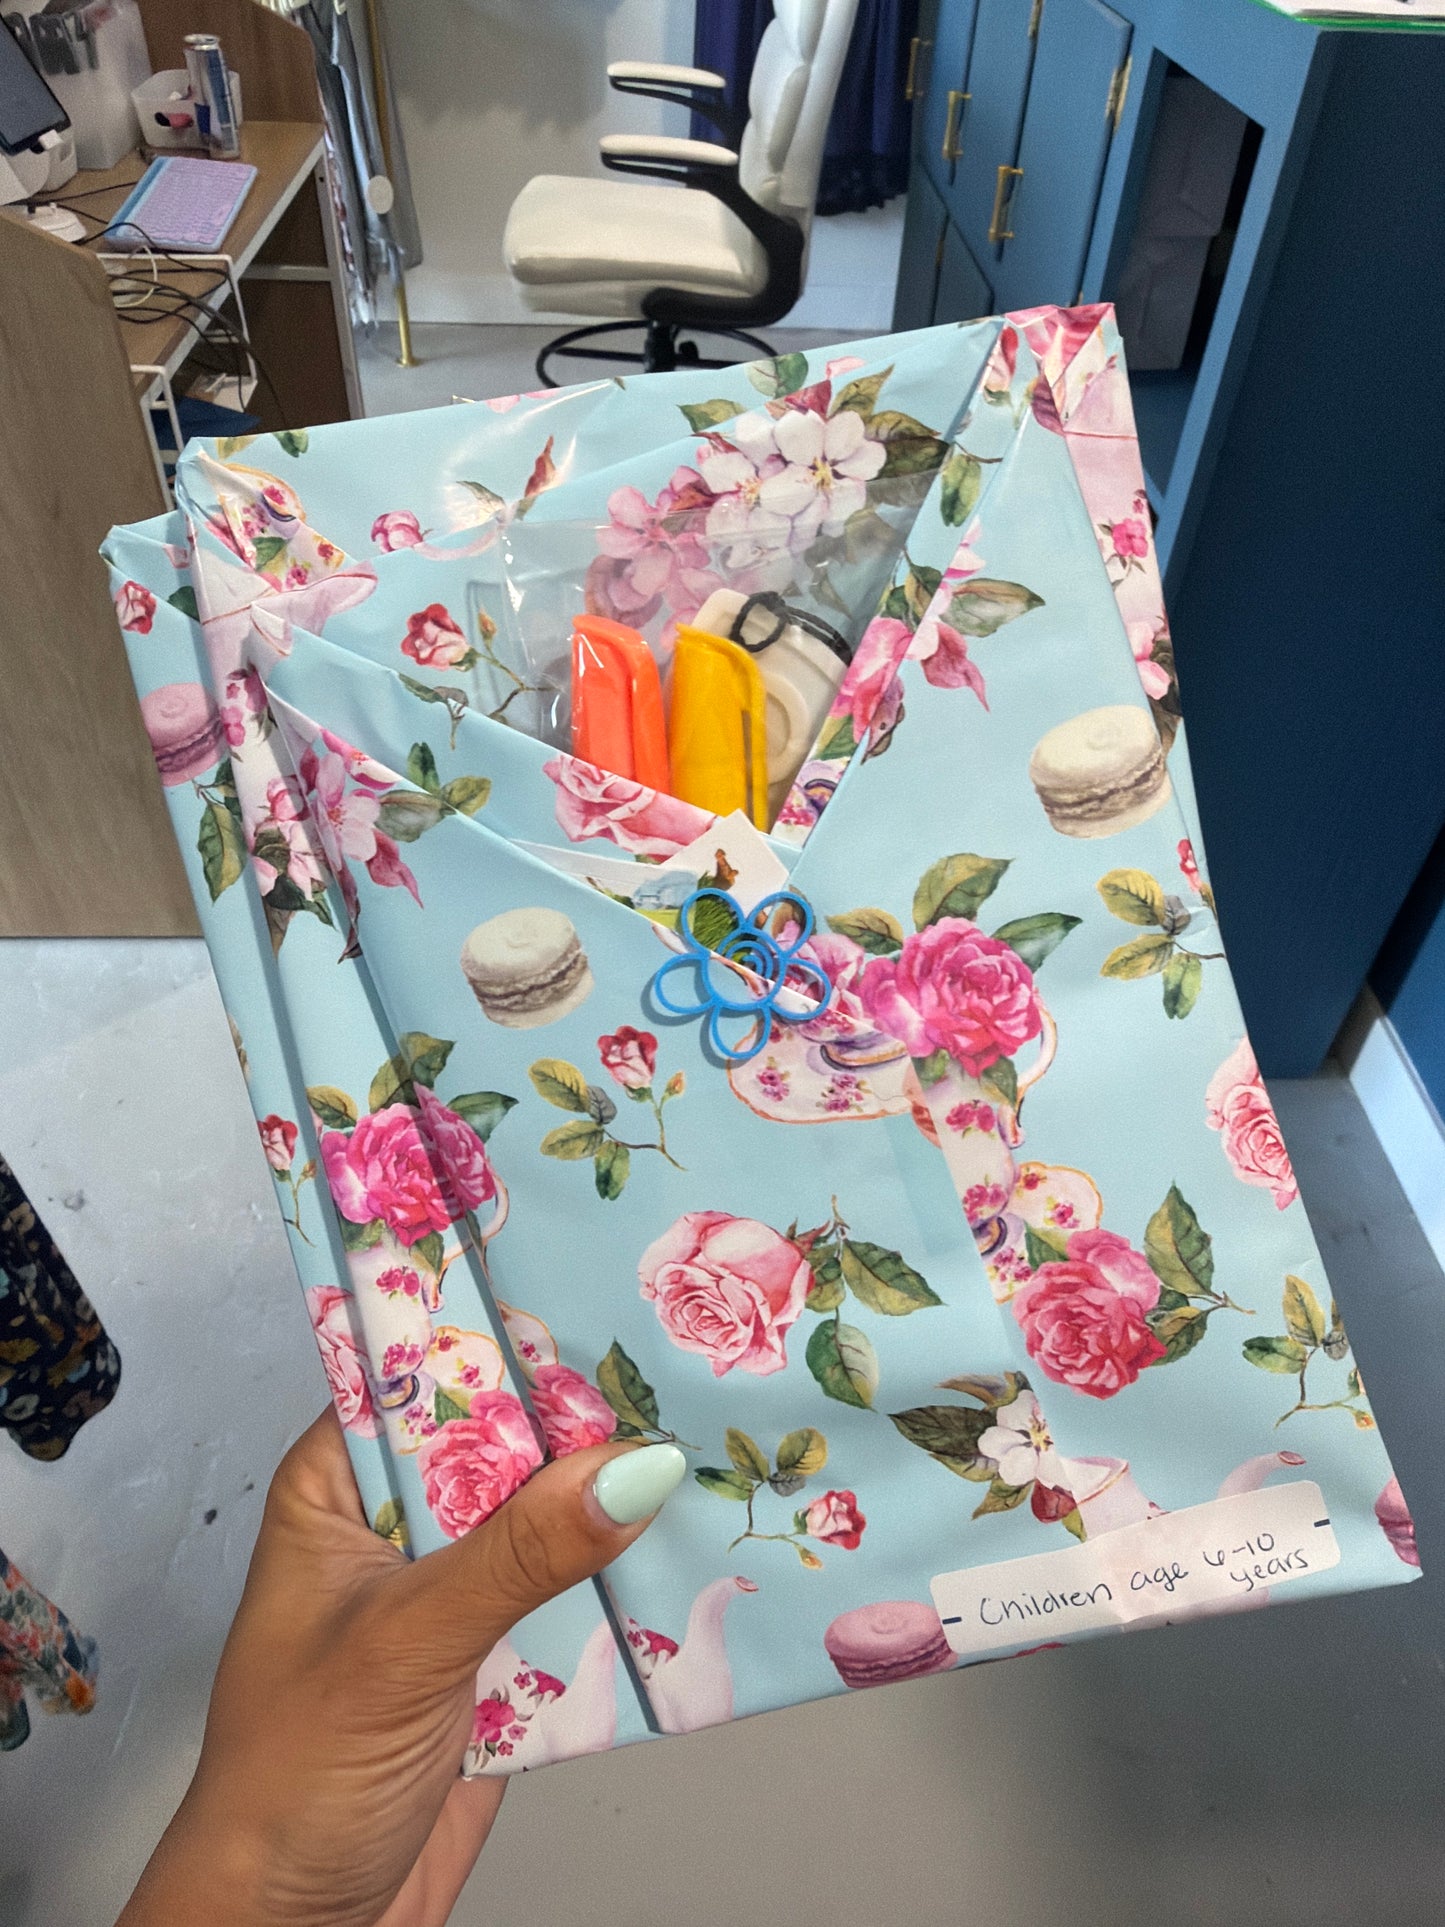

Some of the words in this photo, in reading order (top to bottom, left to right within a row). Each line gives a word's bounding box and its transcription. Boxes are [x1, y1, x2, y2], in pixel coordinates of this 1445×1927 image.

[979, 1582, 1113, 1626] Children
[1130, 1561, 1189, 1592] age
[1202, 1532, 1275, 1567] 6-10
[1229, 1547, 1309, 1592] years
